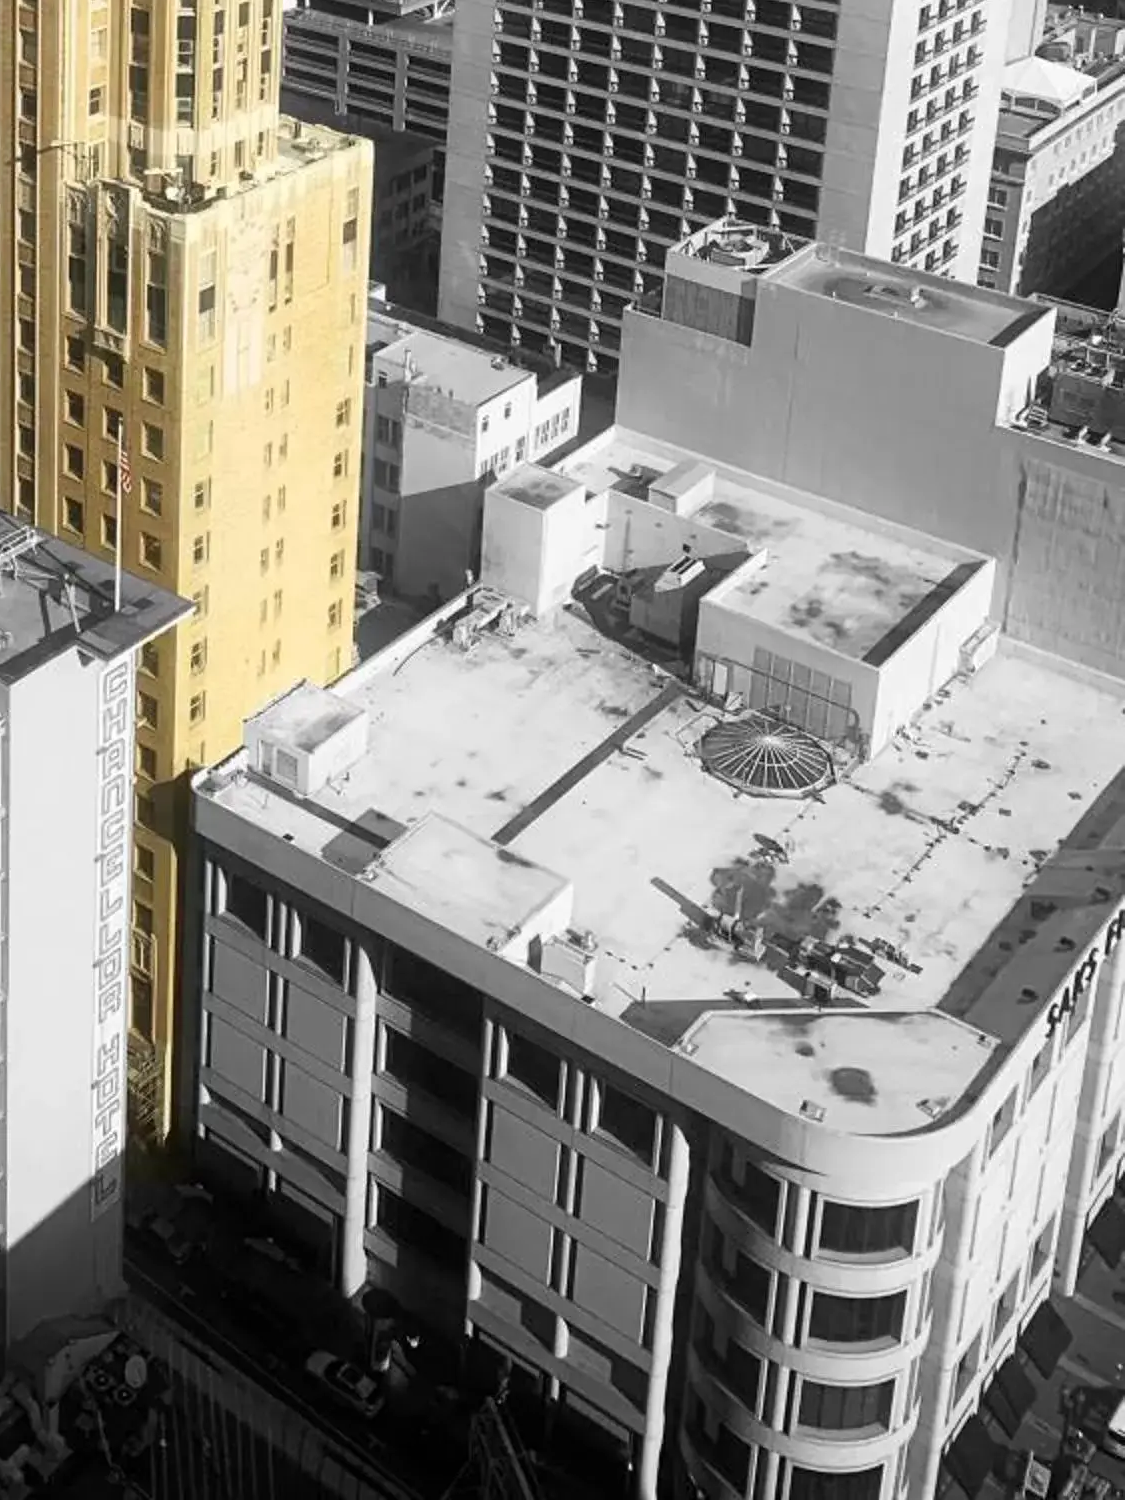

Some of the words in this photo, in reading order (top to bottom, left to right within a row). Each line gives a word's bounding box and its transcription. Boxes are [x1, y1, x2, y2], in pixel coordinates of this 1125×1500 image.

[98, 662, 128, 1024] CHANCELLOR
[1045, 948, 1098, 1039] SAKS
[94, 1033, 120, 1204] HOTEL
